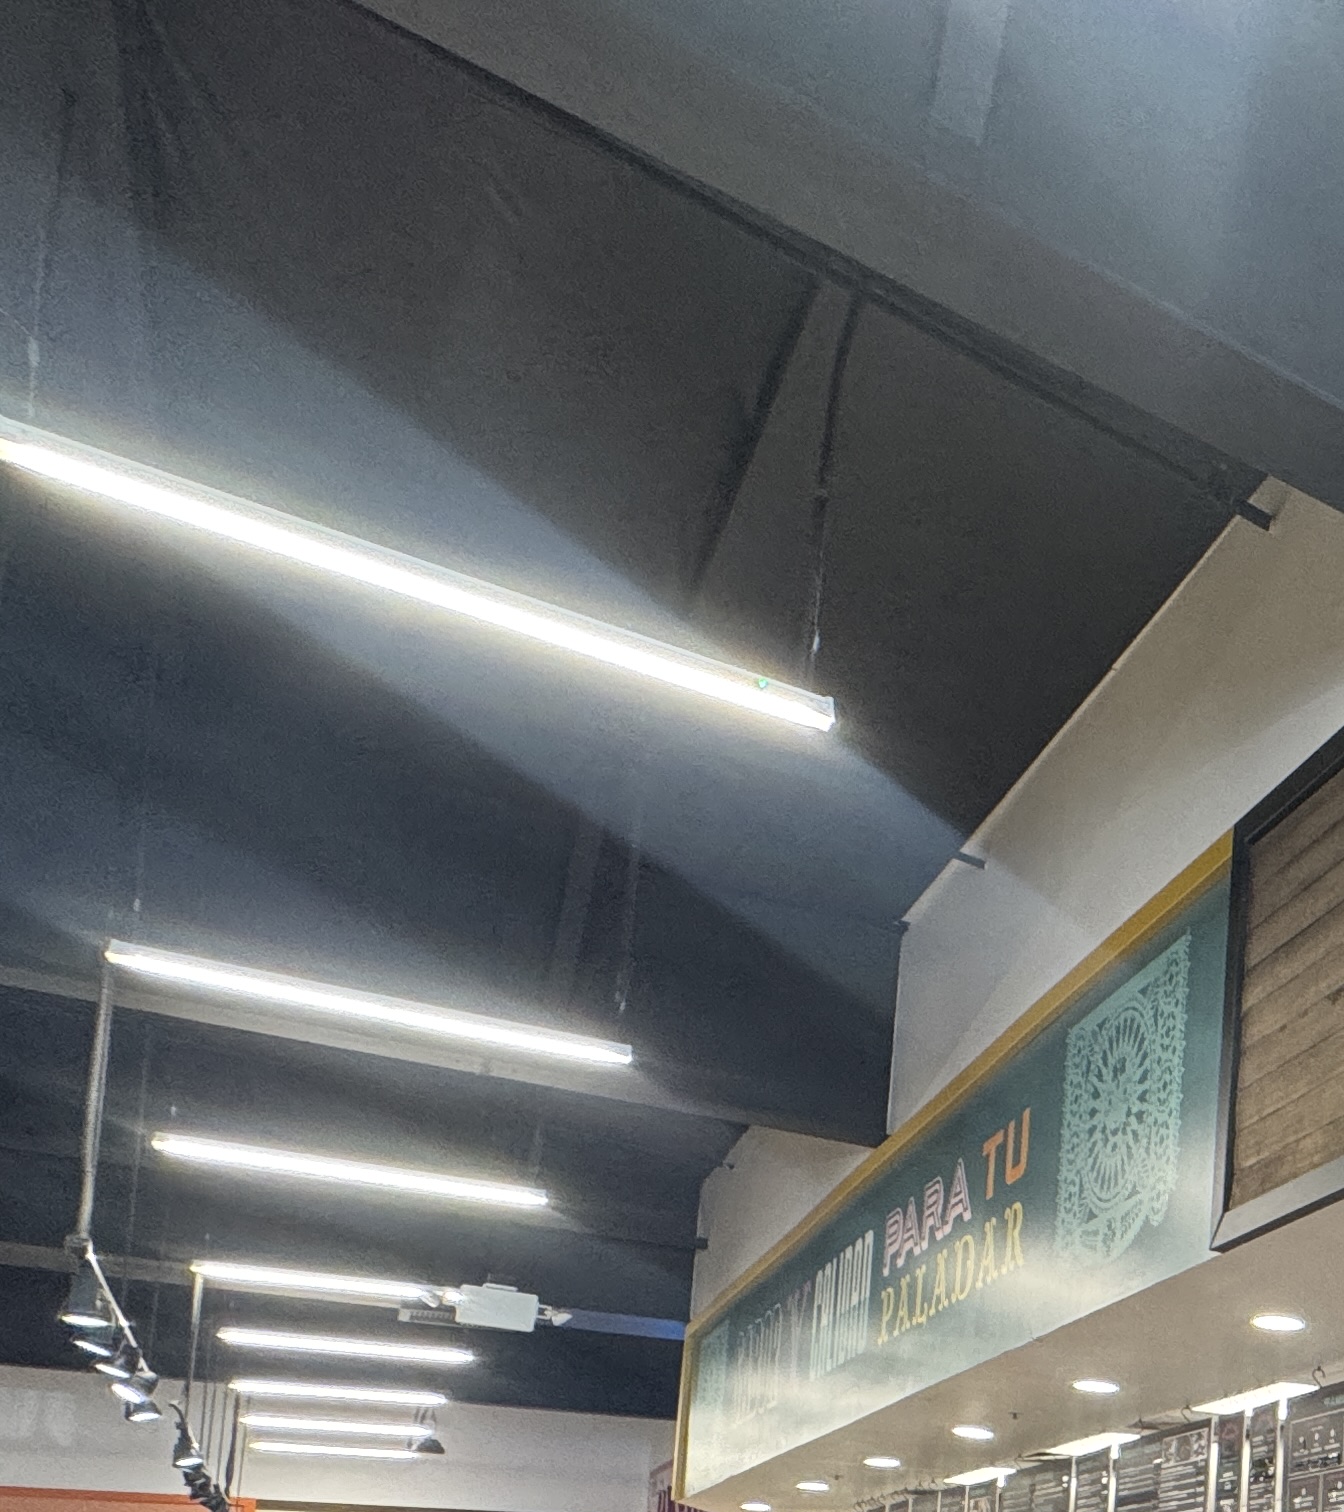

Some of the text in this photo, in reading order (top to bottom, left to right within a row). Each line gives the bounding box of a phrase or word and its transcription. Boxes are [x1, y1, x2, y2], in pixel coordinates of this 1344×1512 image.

[882, 1107, 1031, 1277] PARA TU
[877, 1201, 1025, 1346] PALADAR
